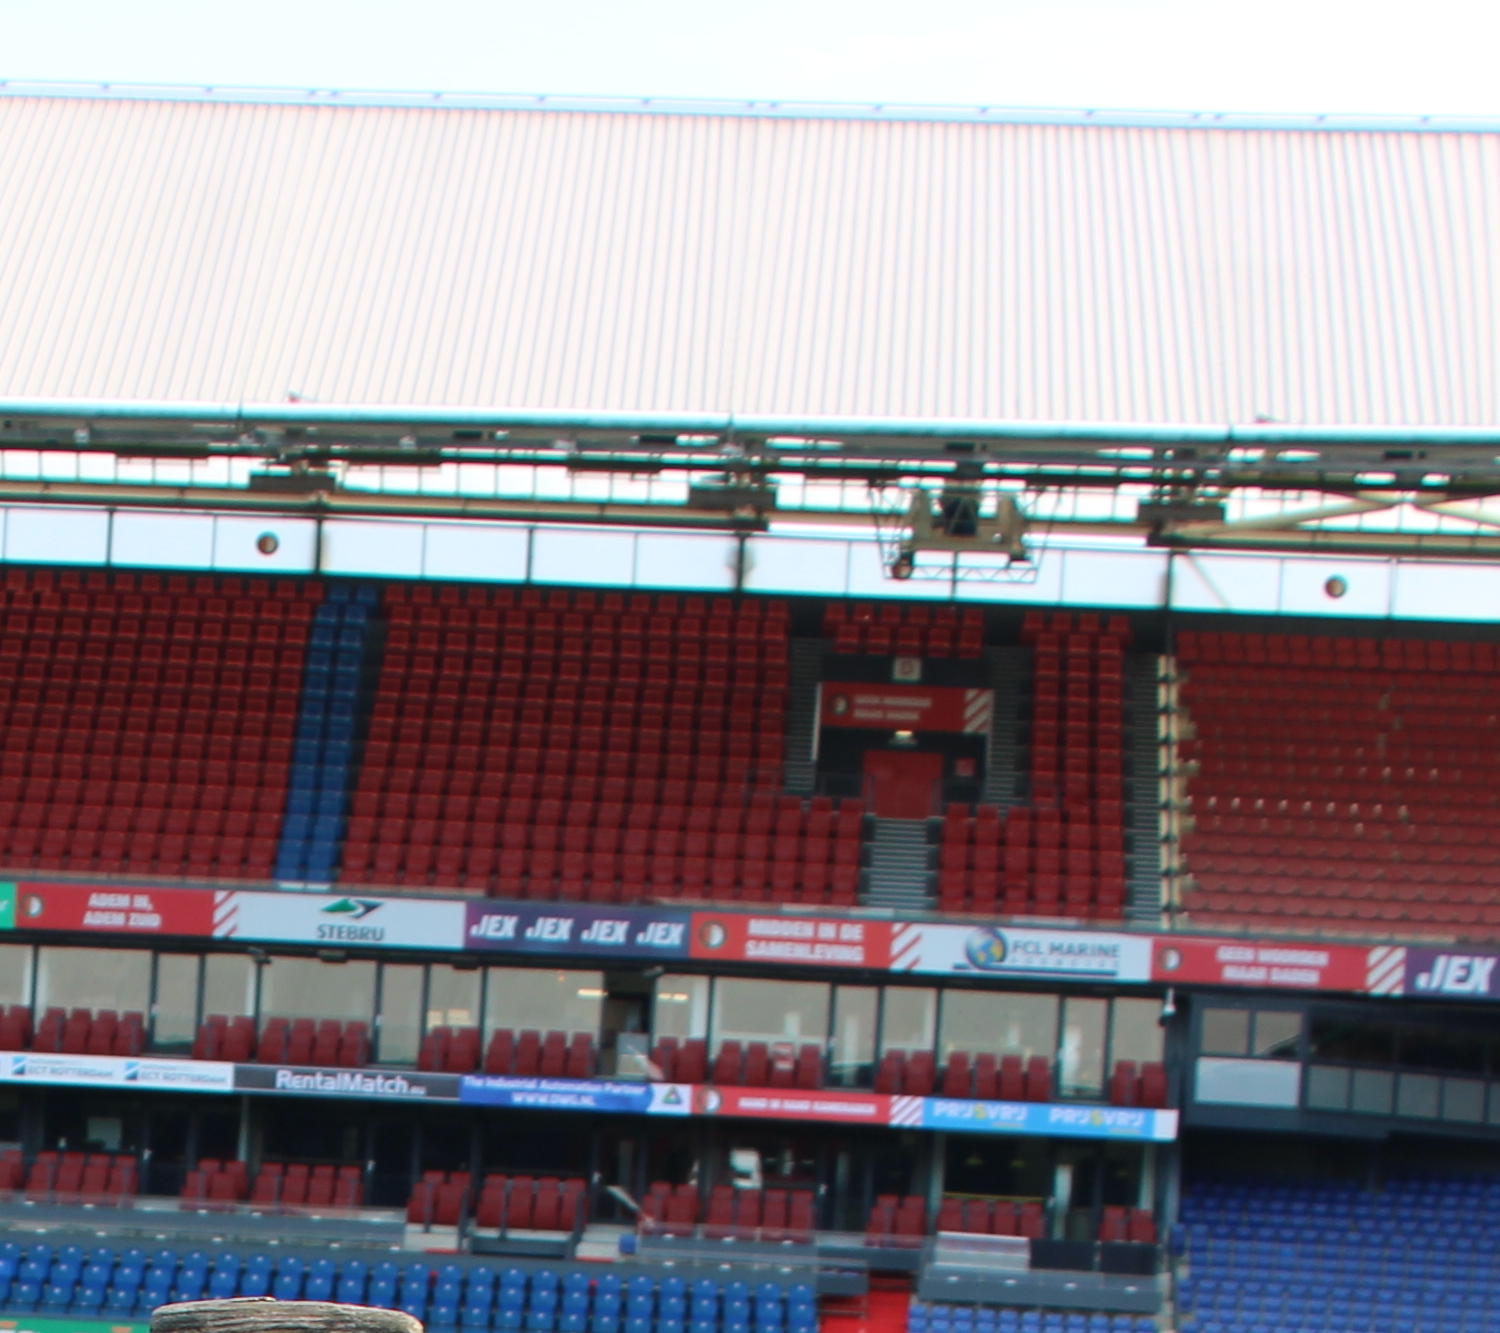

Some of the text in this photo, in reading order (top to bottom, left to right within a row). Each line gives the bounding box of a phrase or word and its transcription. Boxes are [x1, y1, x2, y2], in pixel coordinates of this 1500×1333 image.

[316, 924, 384, 942] STEBRU
[470, 915, 686, 947] JEX JEX JEX JEX
[1012, 940, 1120, 958] FCL MARINE
[1415, 955, 1497, 994] JEX
